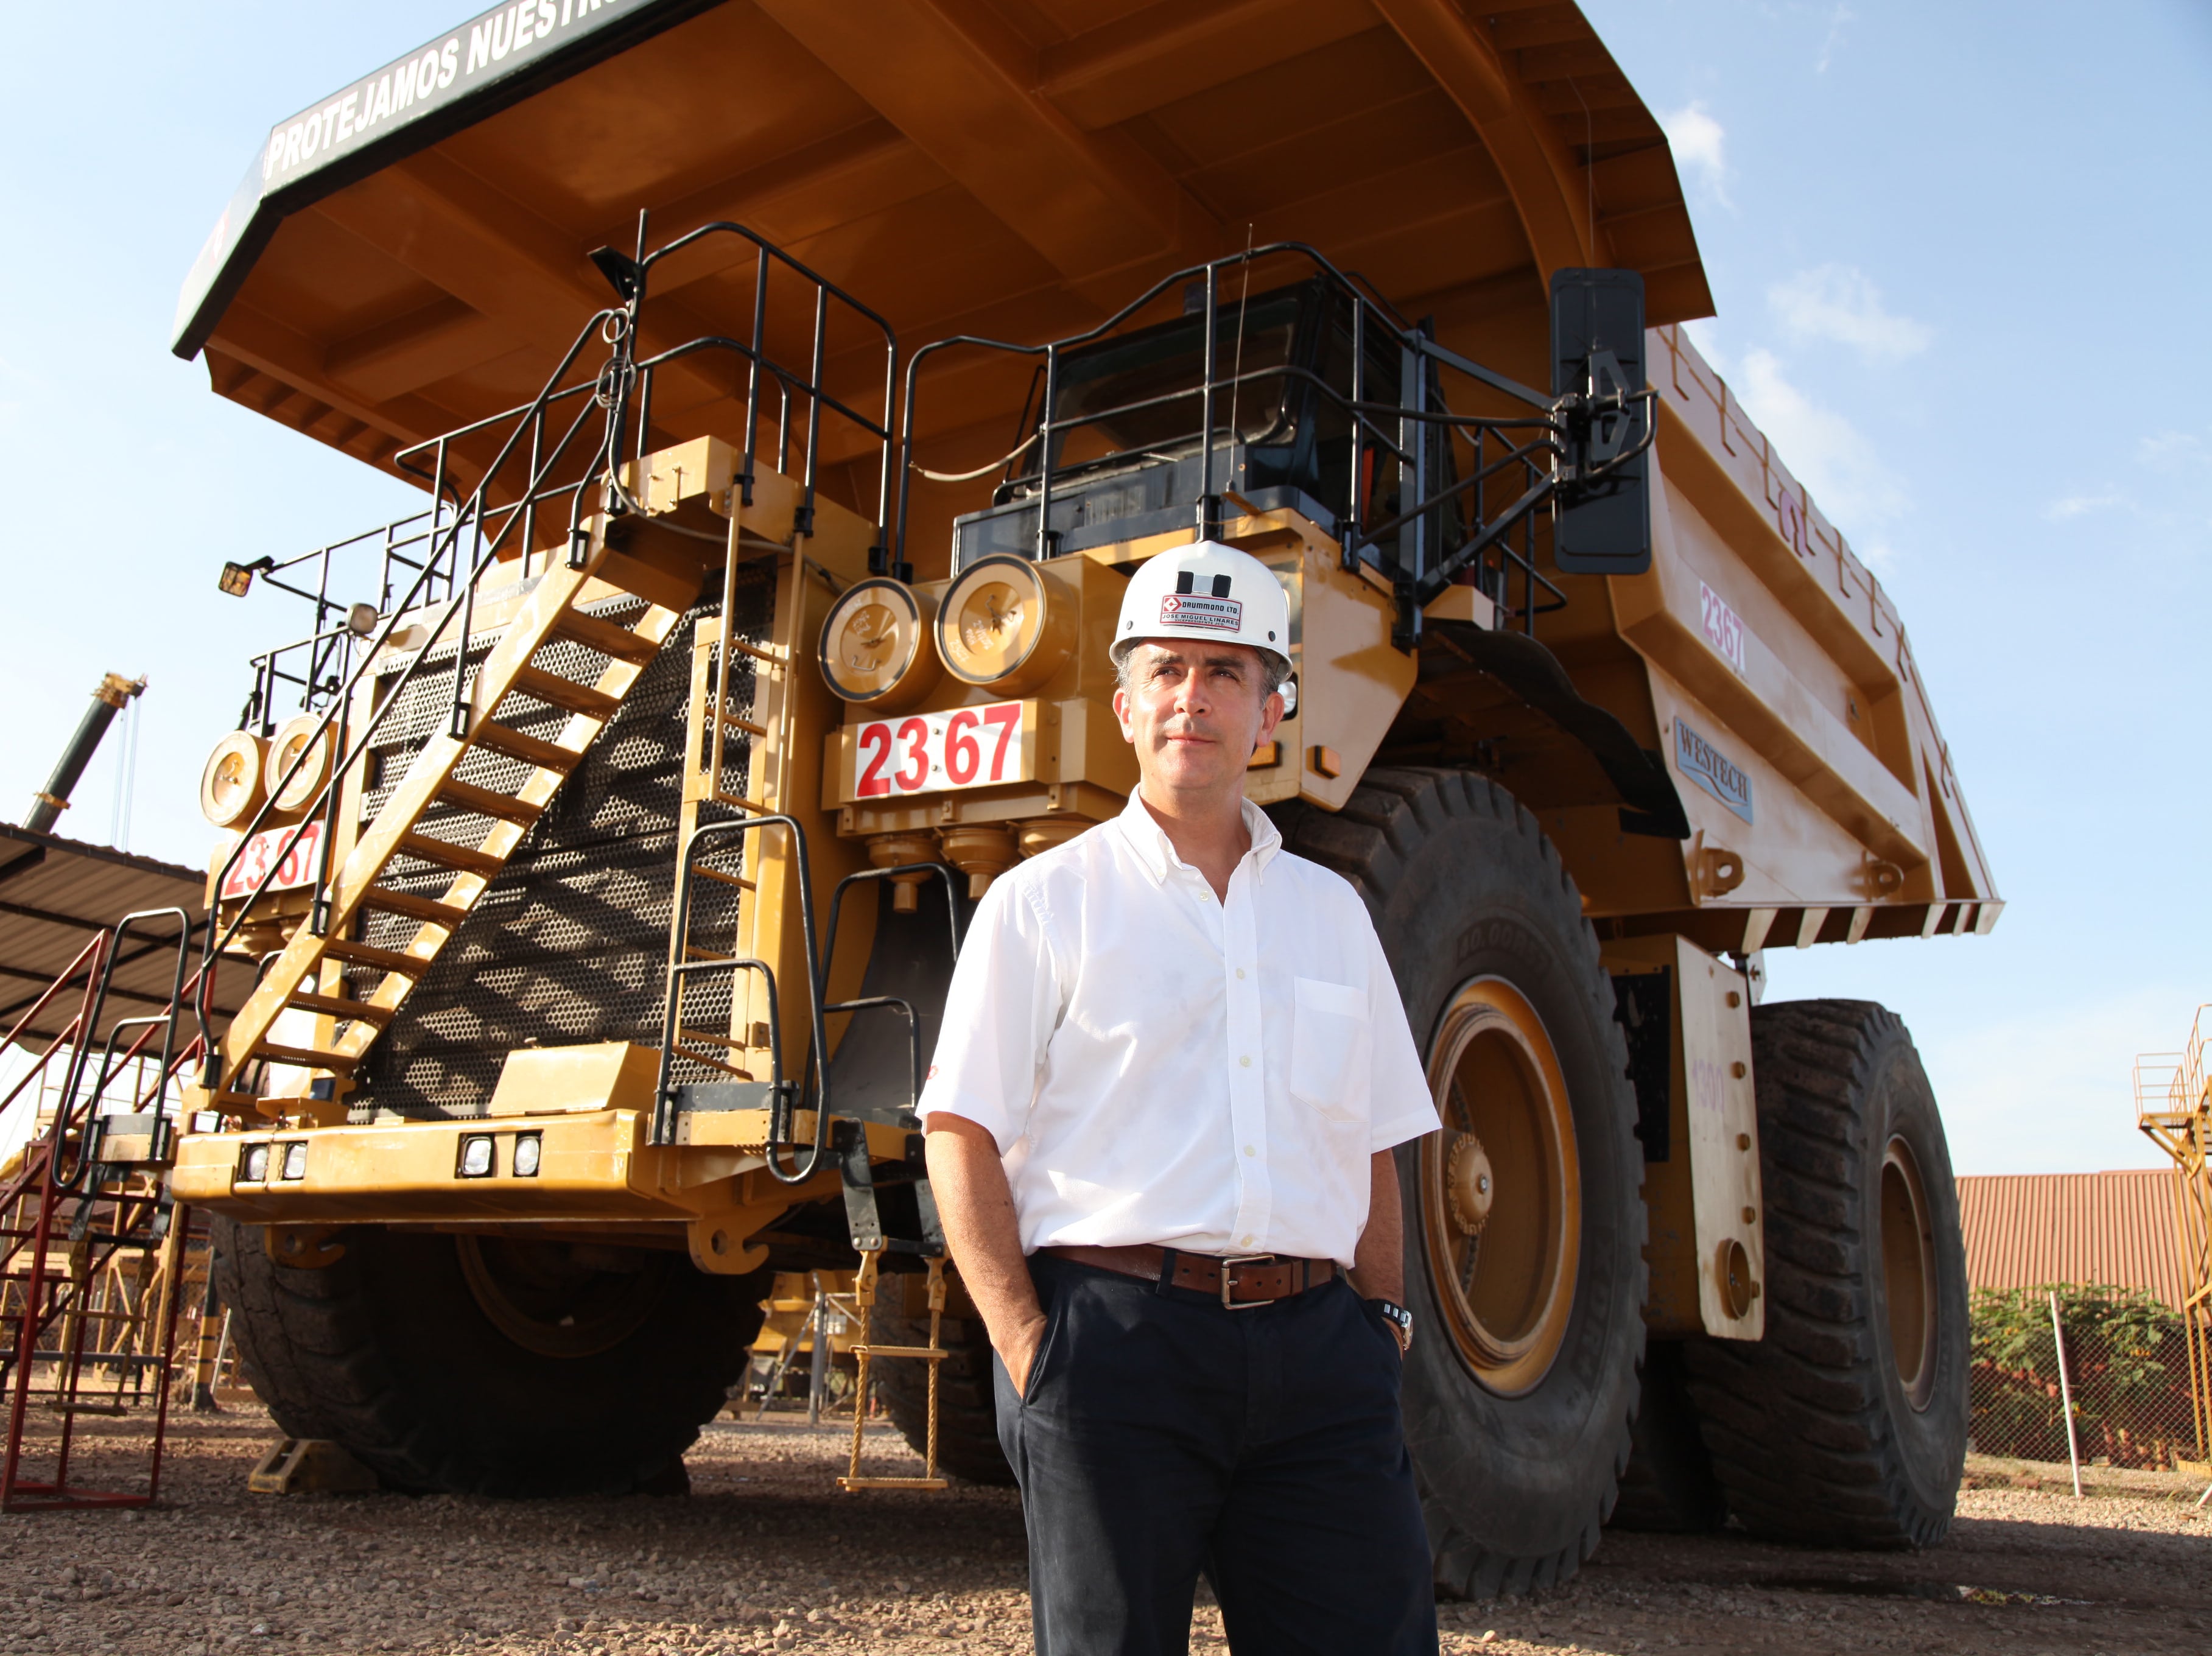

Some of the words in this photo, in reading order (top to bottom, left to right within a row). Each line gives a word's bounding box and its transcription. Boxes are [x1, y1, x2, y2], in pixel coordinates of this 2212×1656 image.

[265, 38, 460, 181] PROTEJAMOS
[466, 0, 617, 74] NUEST
[1182, 602, 1224, 612] DRUMMOND
[1210, 617, 1238, 626] LINARES
[1702, 586, 1743, 665] 2367
[1679, 723, 1748, 802] WESTECH
